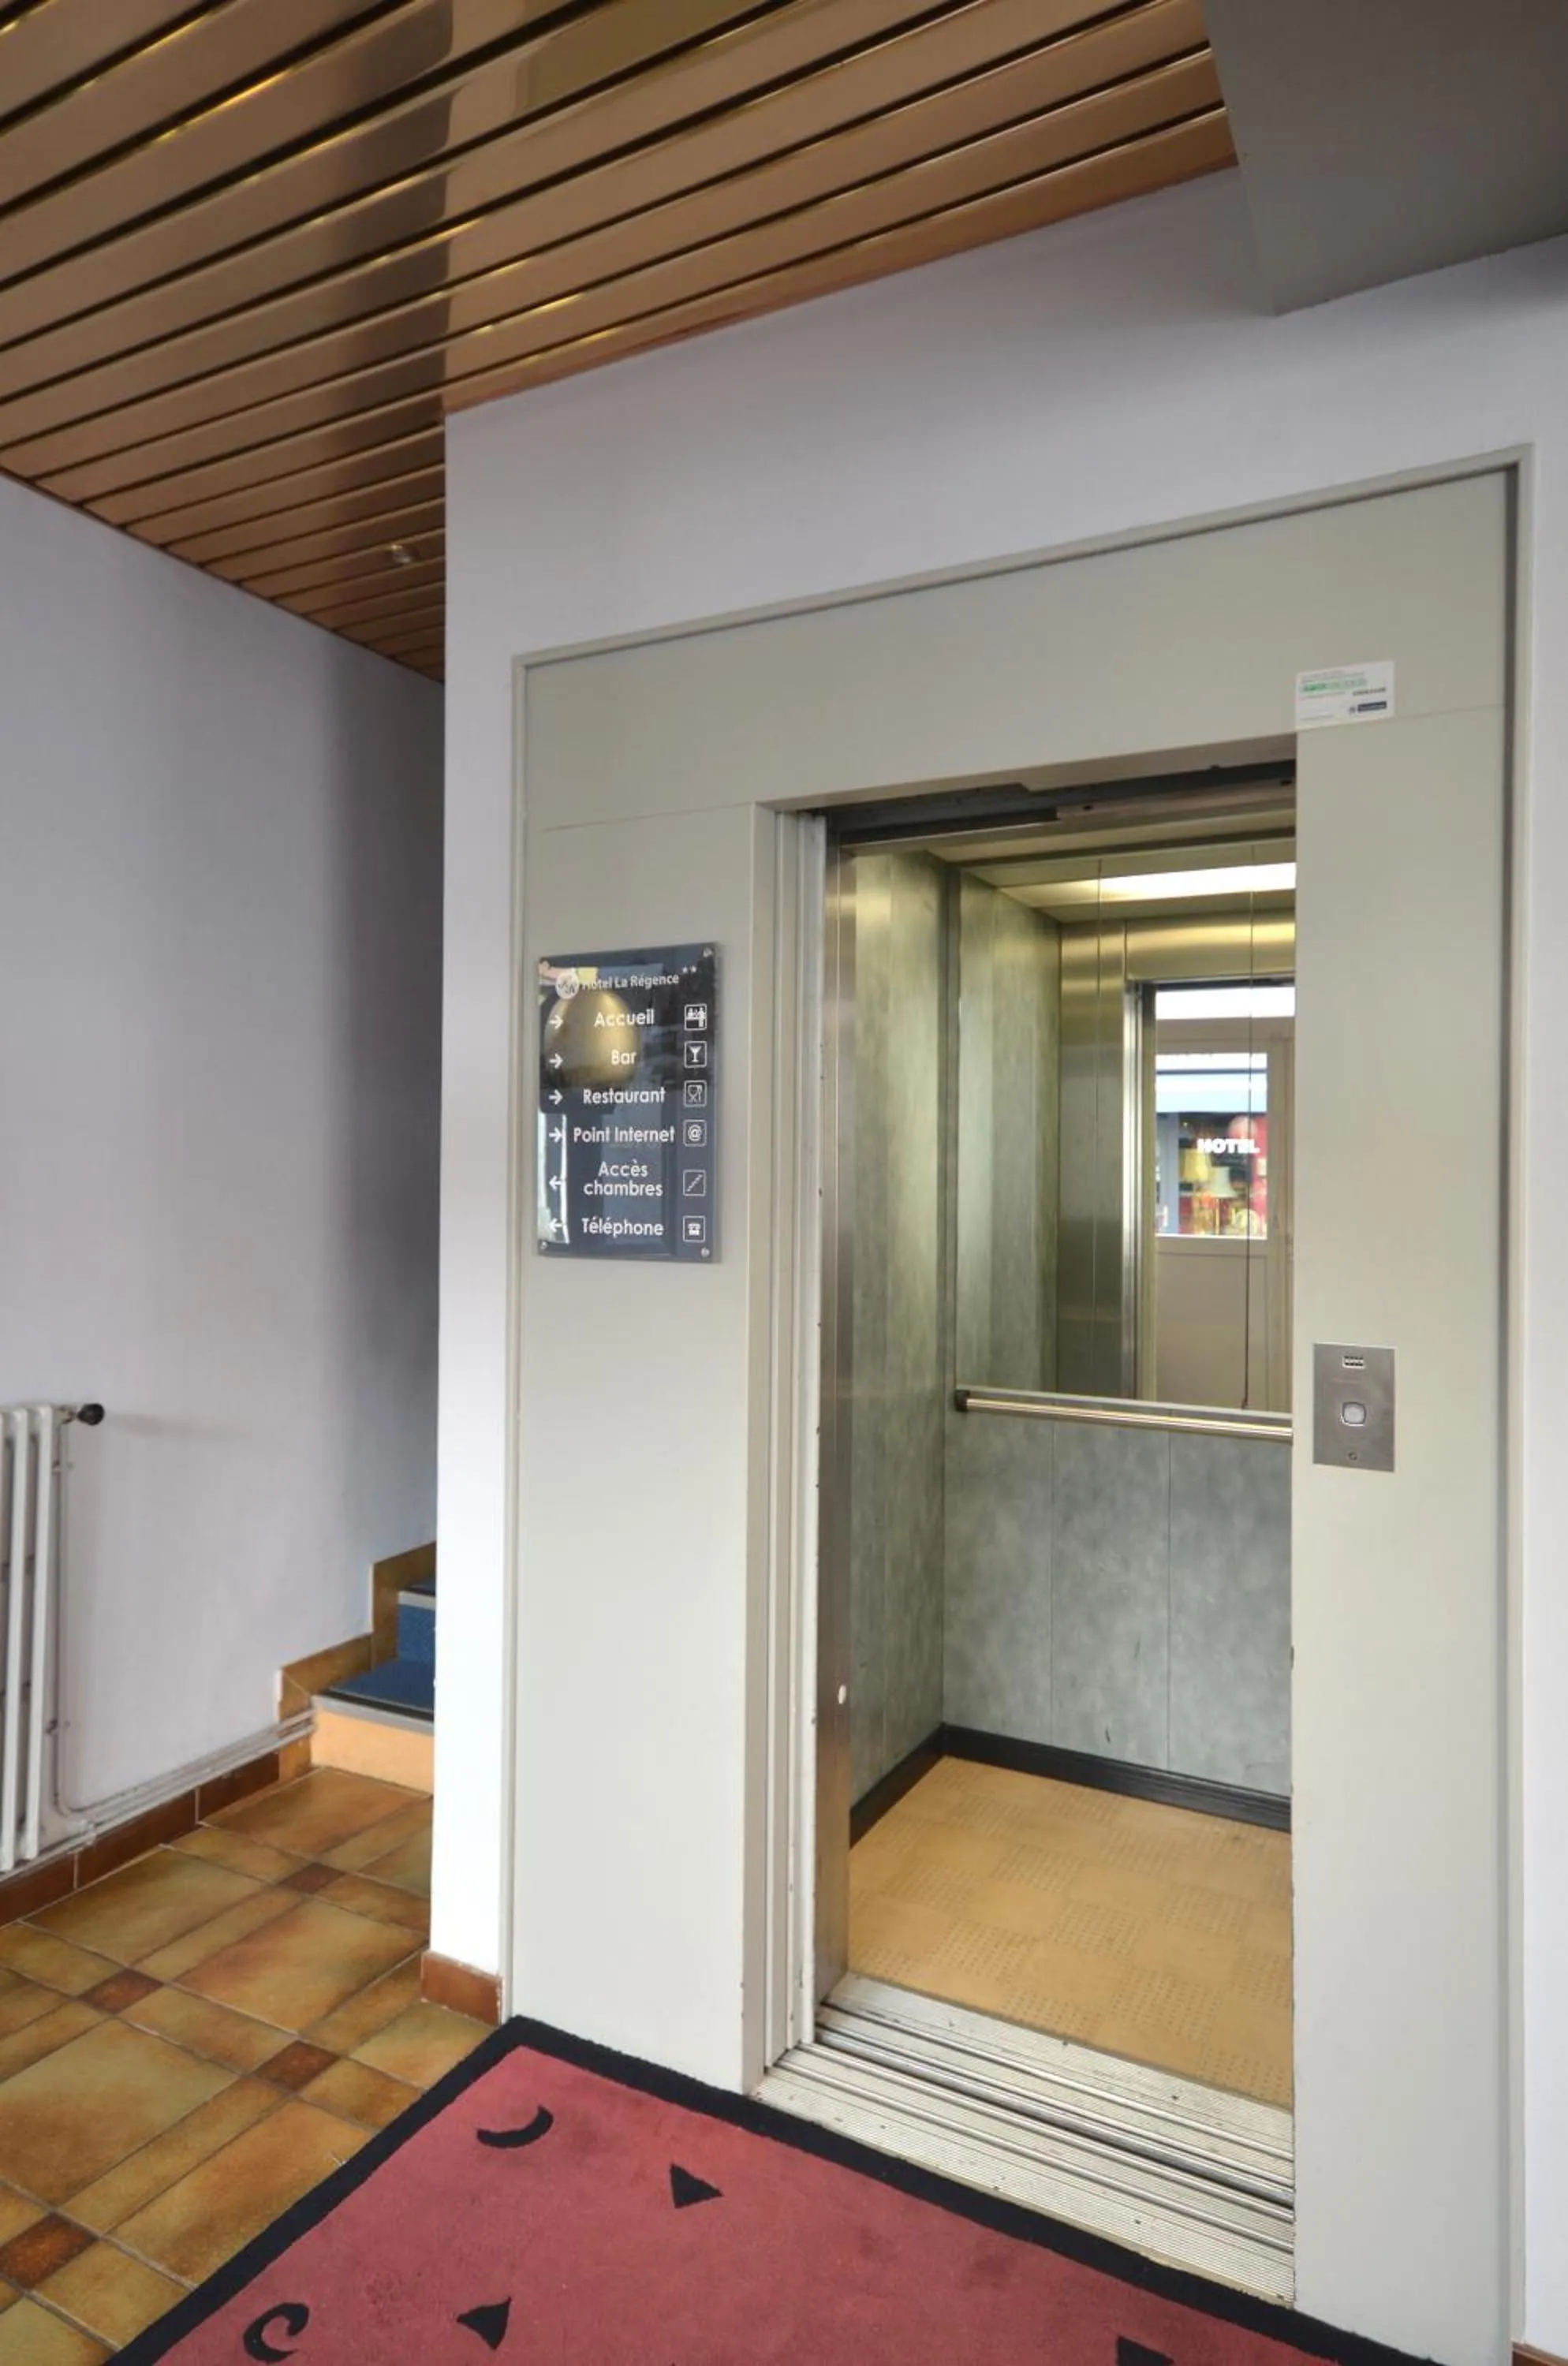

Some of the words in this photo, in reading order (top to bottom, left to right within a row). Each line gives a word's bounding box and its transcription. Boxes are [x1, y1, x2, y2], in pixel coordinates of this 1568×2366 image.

[614, 976, 629, 988] La
[630, 973, 680, 990] Régence
[594, 1009, 655, 1028] Accueil
[610, 1050, 637, 1065] Bar
[583, 1087, 666, 1104] Restaurant
[573, 1127, 610, 1144] Point
[614, 1125, 675, 1144] Internet
[1197, 1138, 1261, 1154] HOTEL
[598, 1159, 648, 1177] Accès
[583, 1181, 663, 1197] chambres
[581, 1216, 665, 1238] Téléphone
